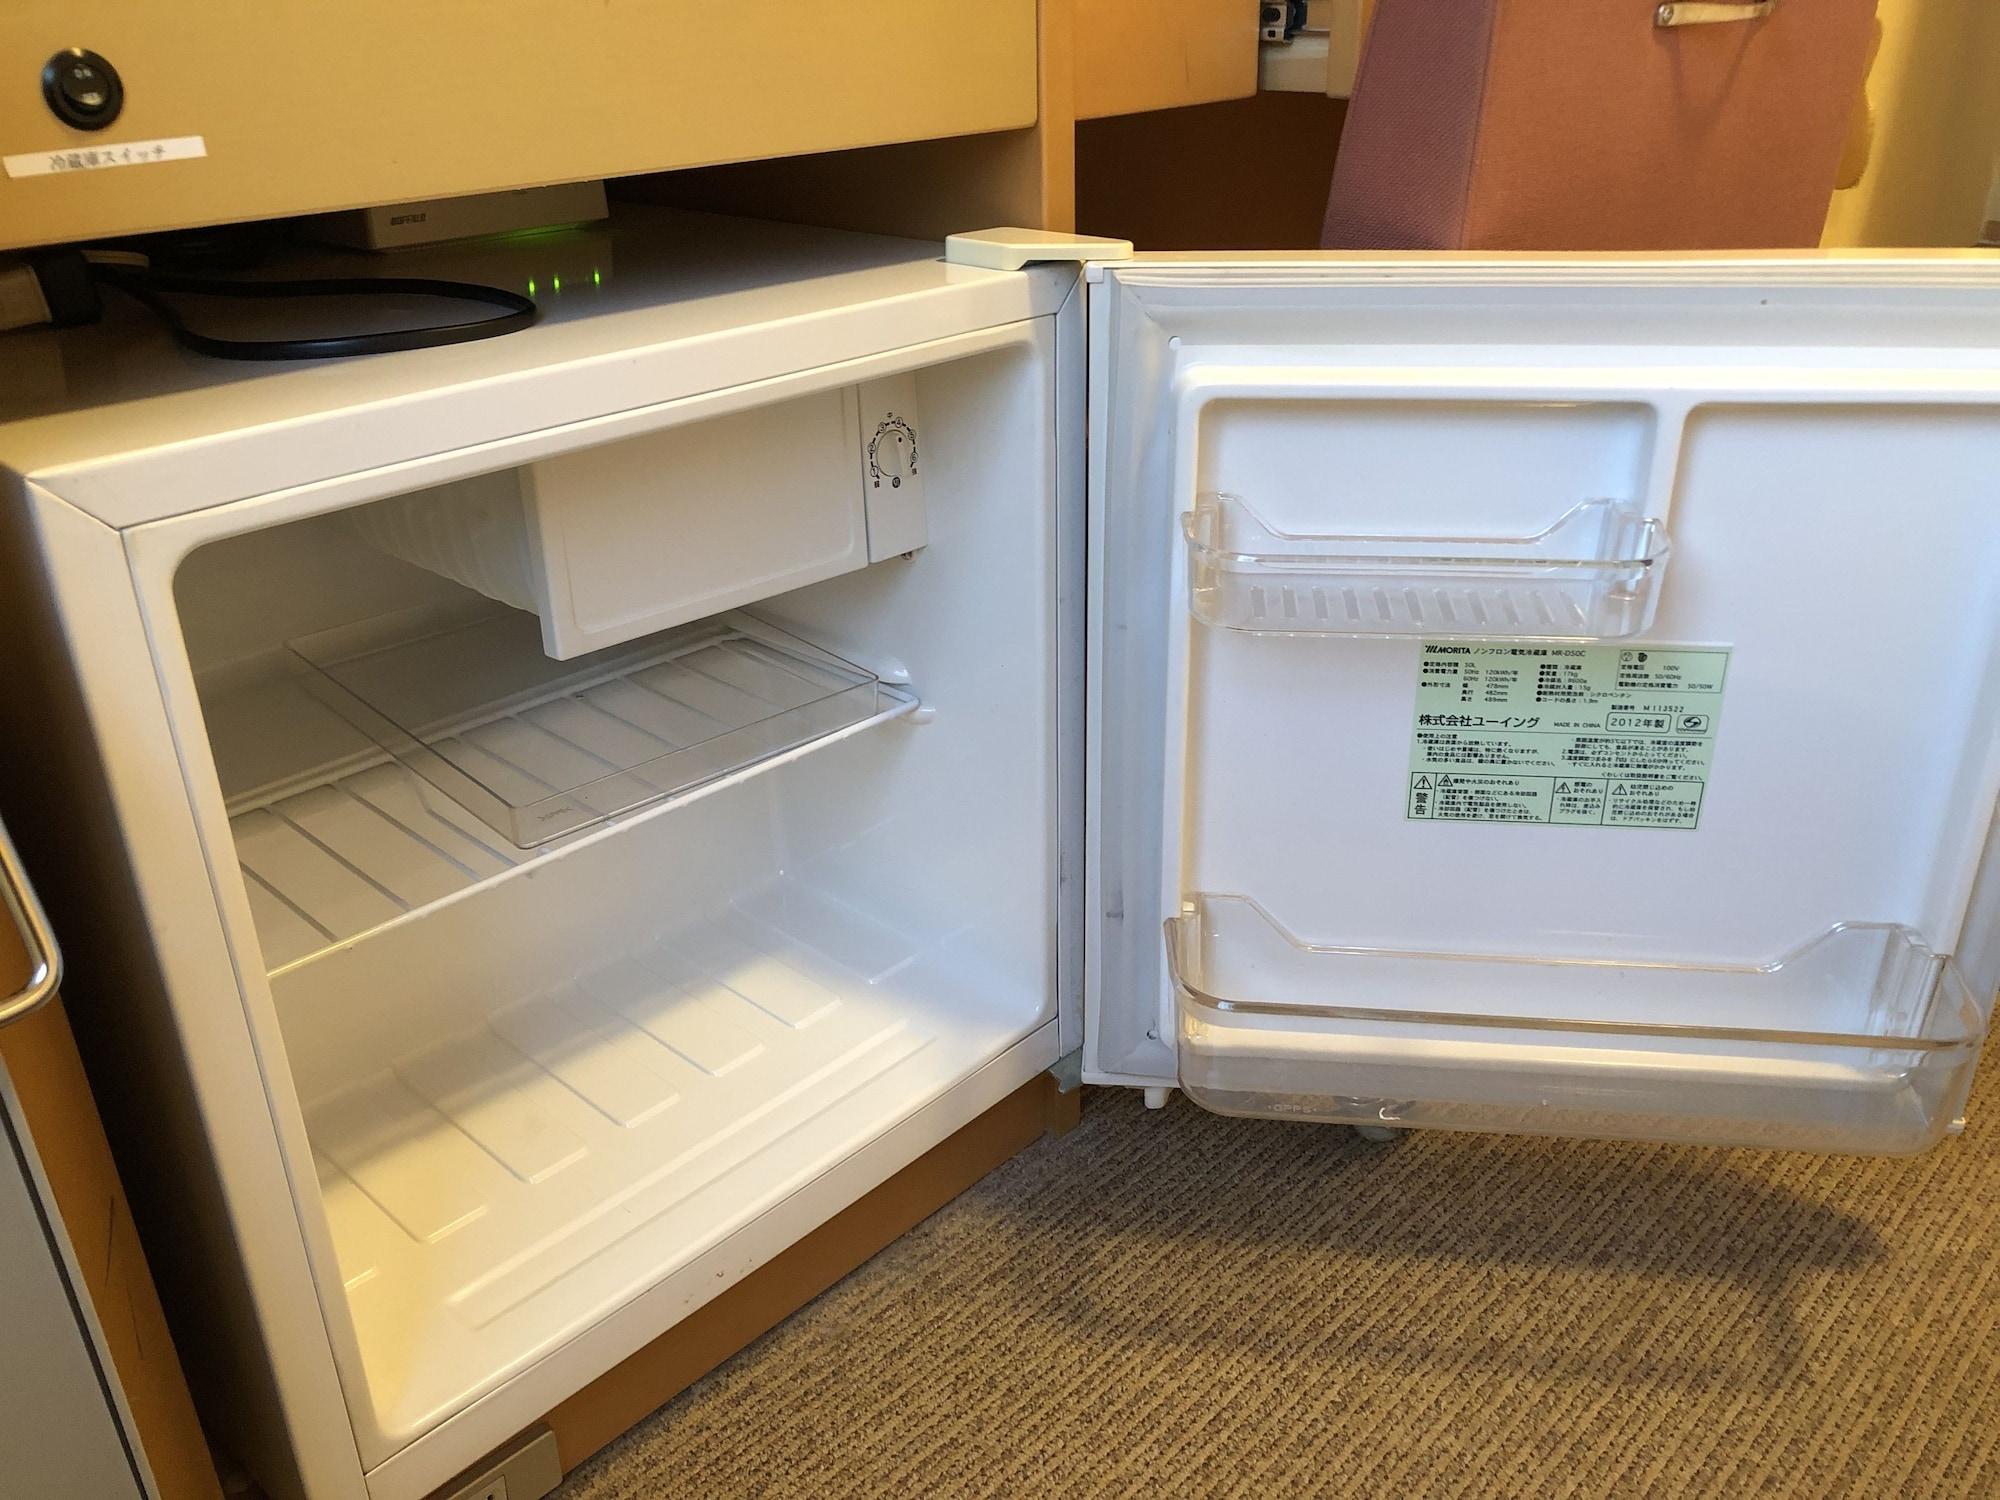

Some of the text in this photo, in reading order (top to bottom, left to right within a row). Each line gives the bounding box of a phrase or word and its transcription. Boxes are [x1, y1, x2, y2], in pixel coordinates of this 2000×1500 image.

[49, 145, 166, 170] 冷蔵庫スイッチ
[1432, 646, 1471, 654] MORITA
[1419, 714, 1540, 728] 株式会社ユーイング
[1610, 718, 1665, 728] 2012年製
[1414, 792, 1428, 815] 警告
